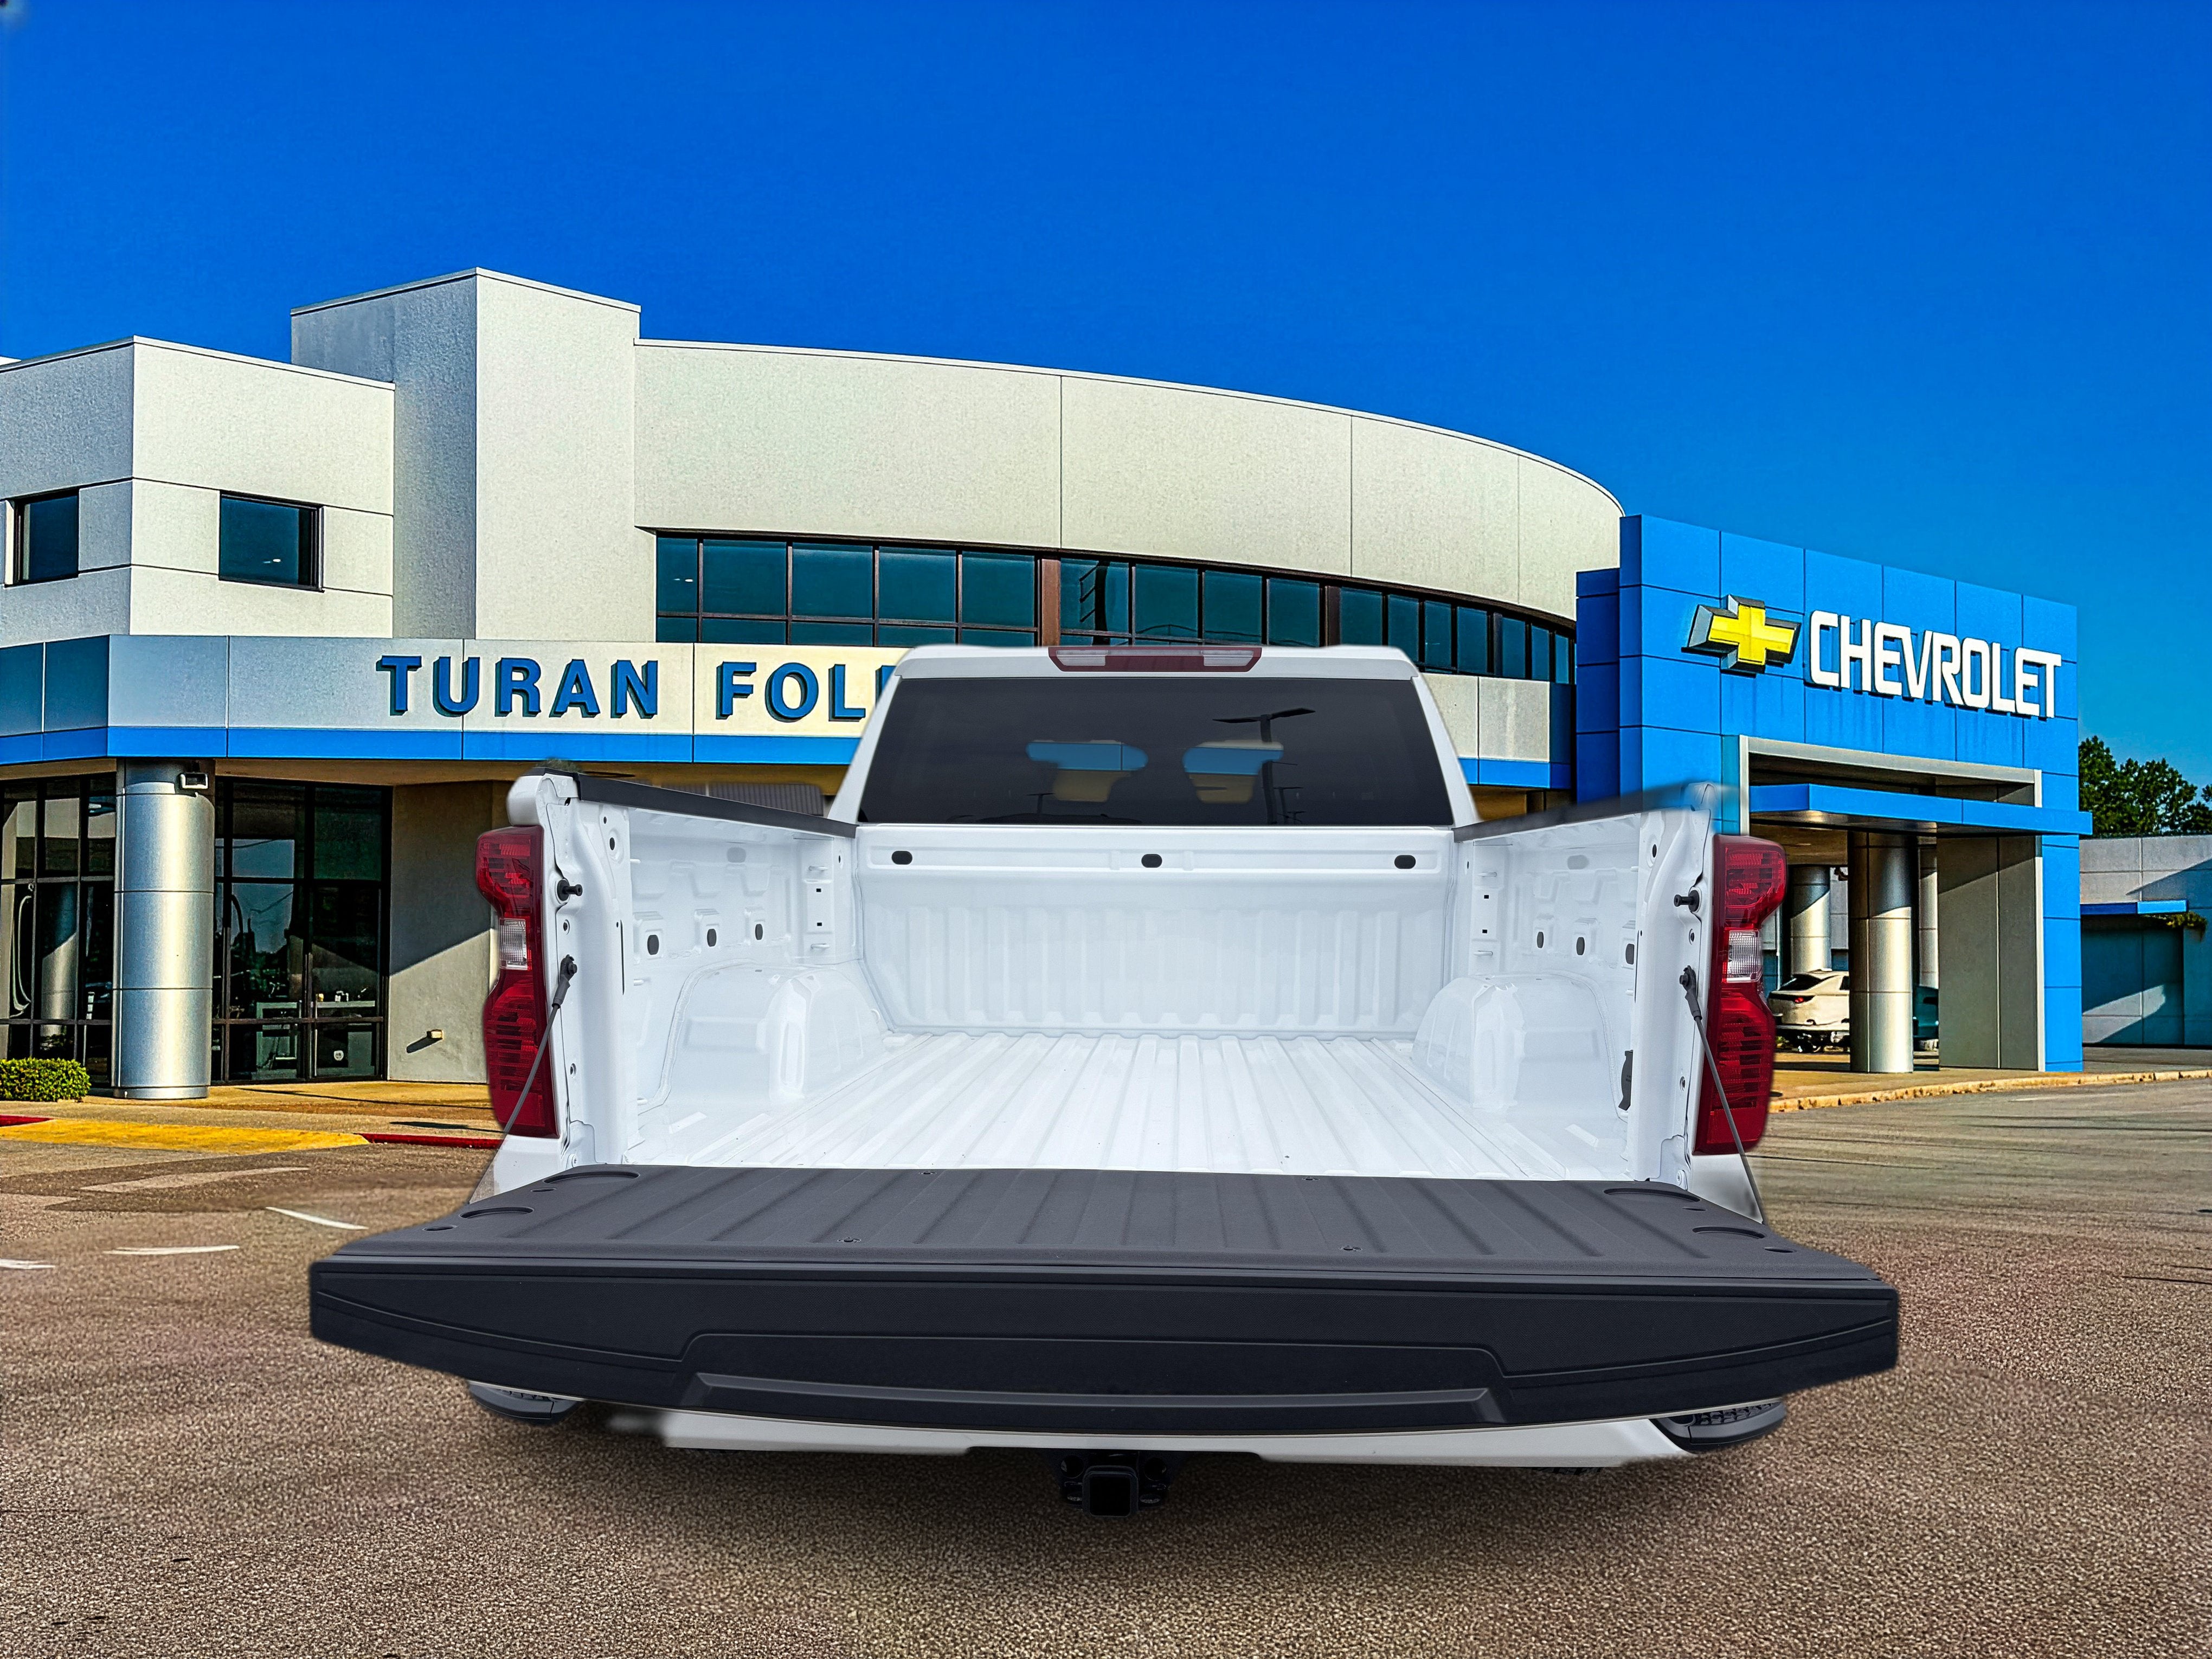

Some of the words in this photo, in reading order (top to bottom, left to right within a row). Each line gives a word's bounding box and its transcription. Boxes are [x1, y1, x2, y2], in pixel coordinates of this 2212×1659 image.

[377, 655, 658, 719] TURAN
[716, 661, 896, 723] FOL
[1810, 610, 2062, 718] CHEVROLET
